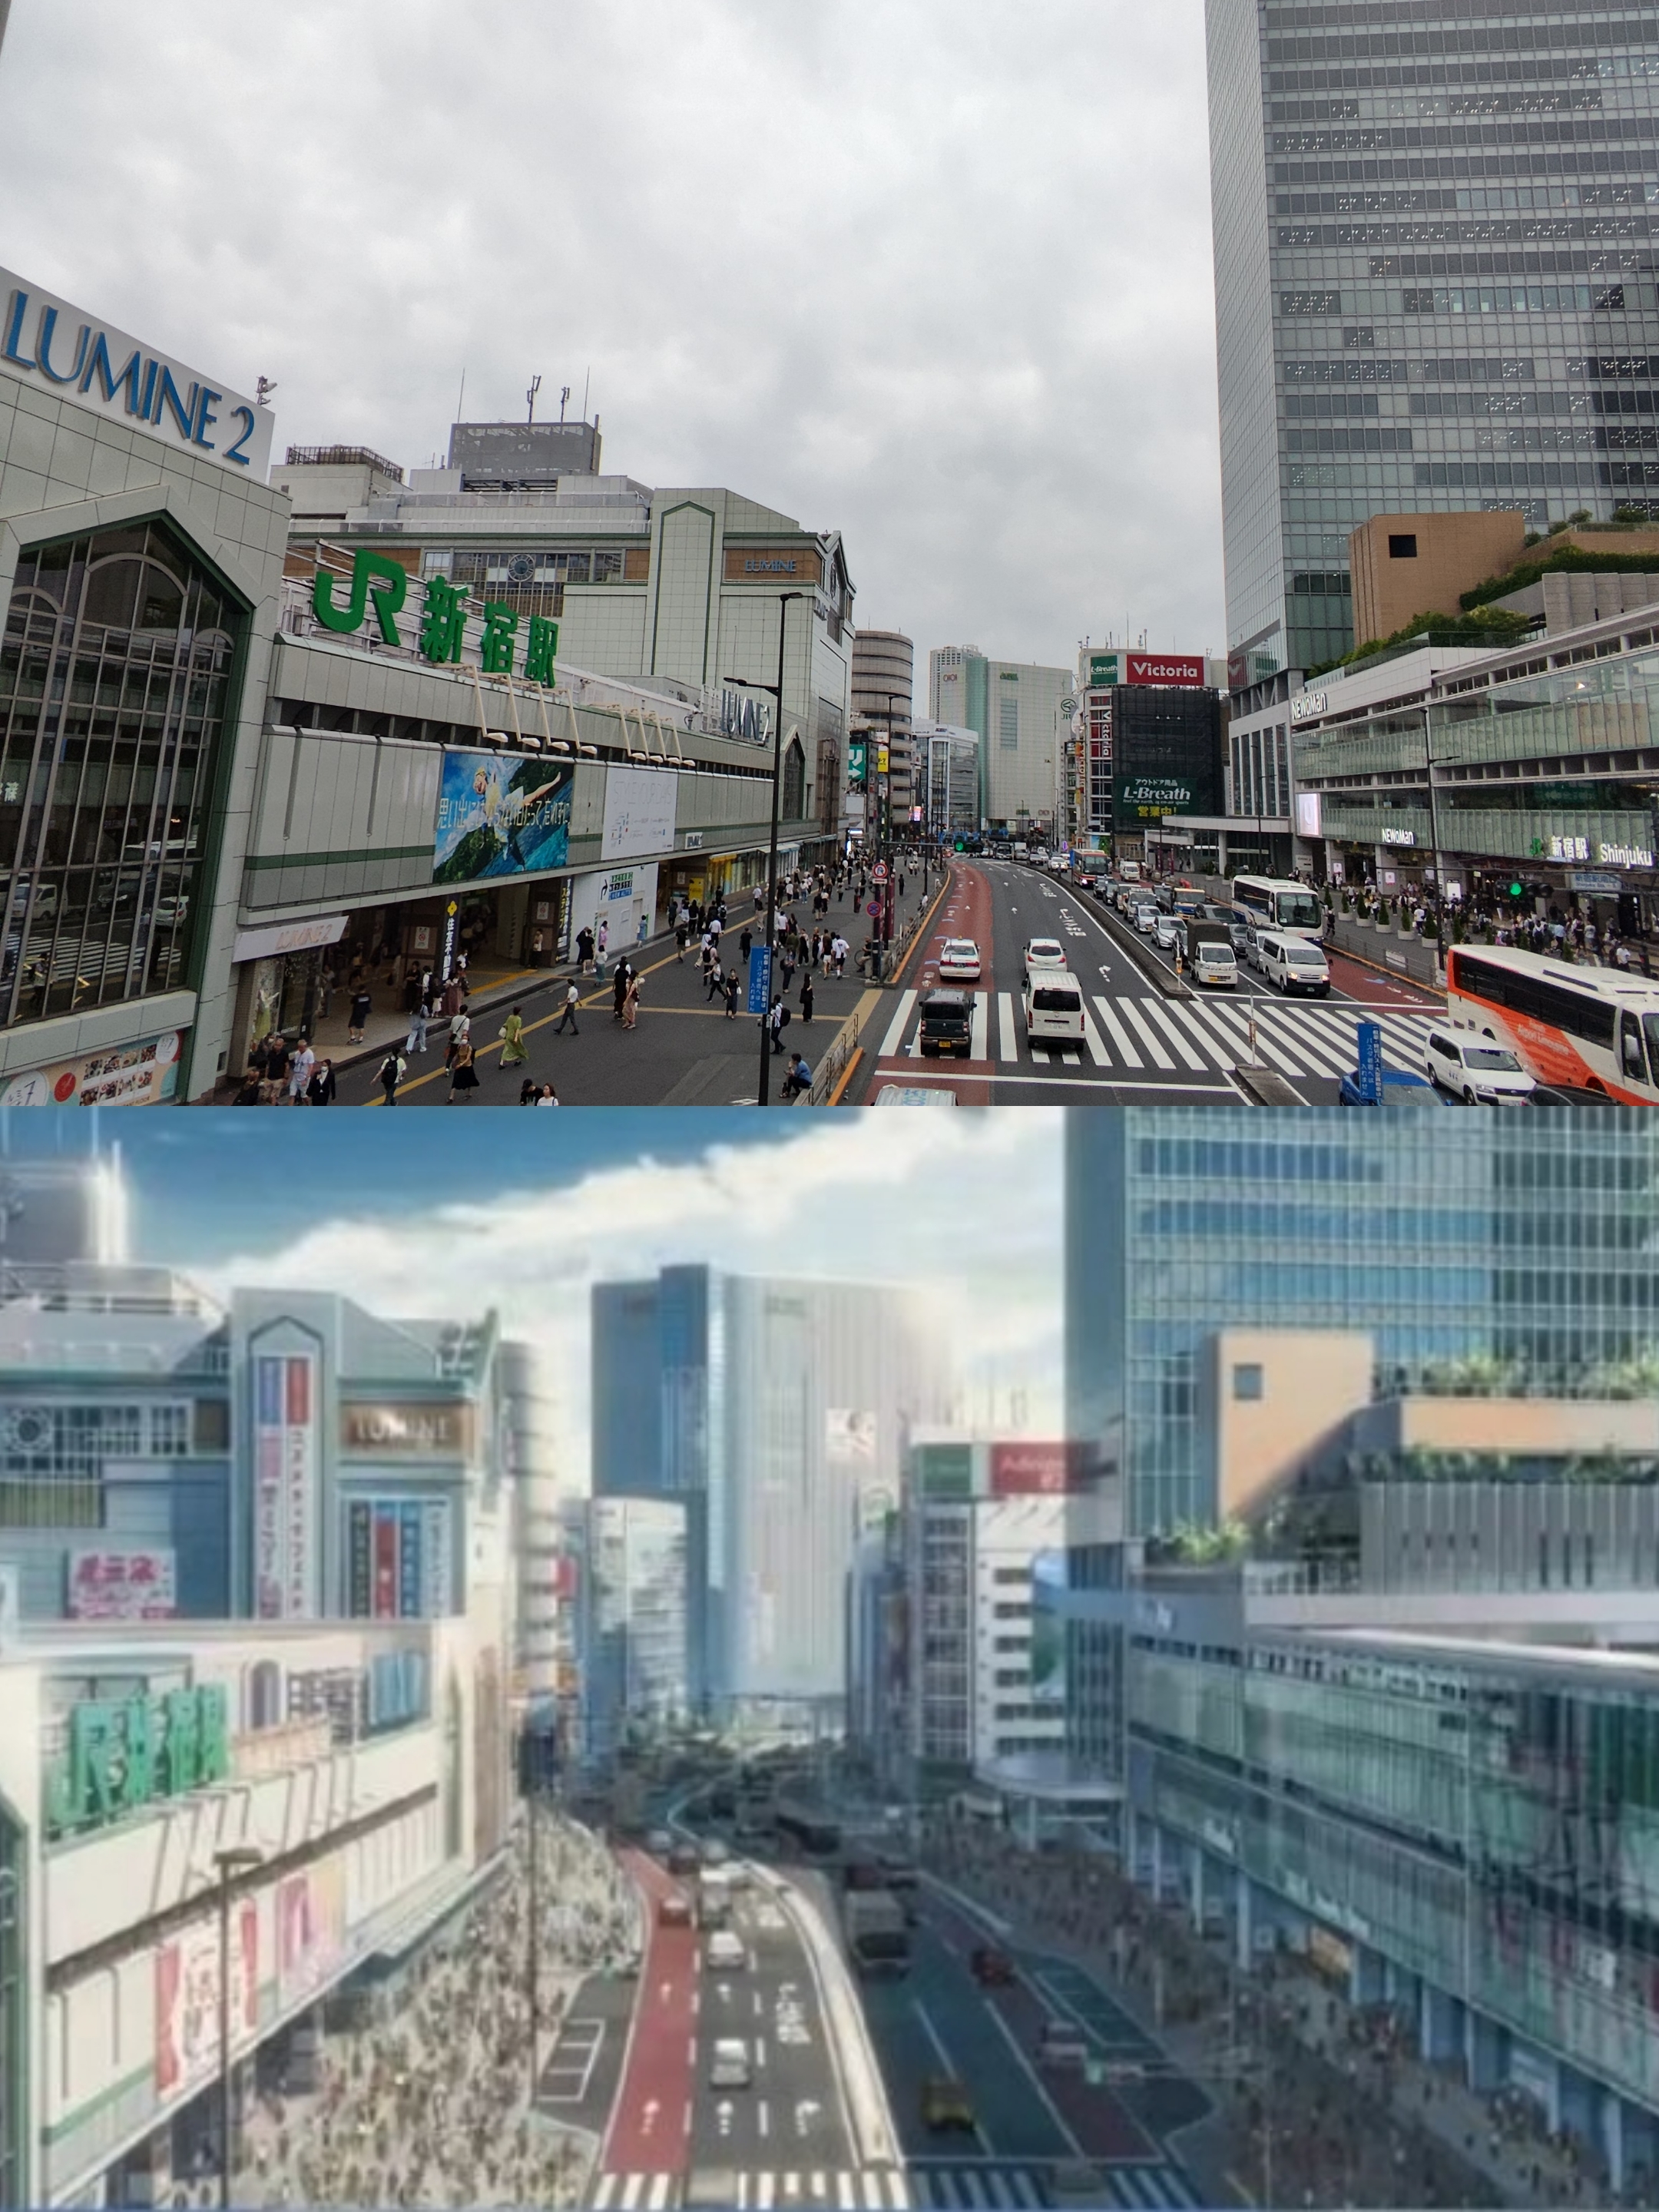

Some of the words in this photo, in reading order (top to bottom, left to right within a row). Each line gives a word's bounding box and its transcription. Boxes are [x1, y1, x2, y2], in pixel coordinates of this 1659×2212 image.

[2, 289, 221, 450] LUMINE
[223, 406, 255, 465] 2
[745, 559, 796, 573] LUMINE
[313, 548, 406, 647] JR
[420, 575, 558, 688] 新宿駅
[1091, 665, 1118, 674] L-Breath
[1132, 662, 1197, 677] Victoria
[1103, 710, 1111, 756] Vctoria
[1124, 786, 1190, 800] L-Breath
[1382, 828, 1415, 845] NEWoMan
[1551, 835, 1588, 859] 新宿駅
[1600, 843, 1653, 869] Shinjuku
